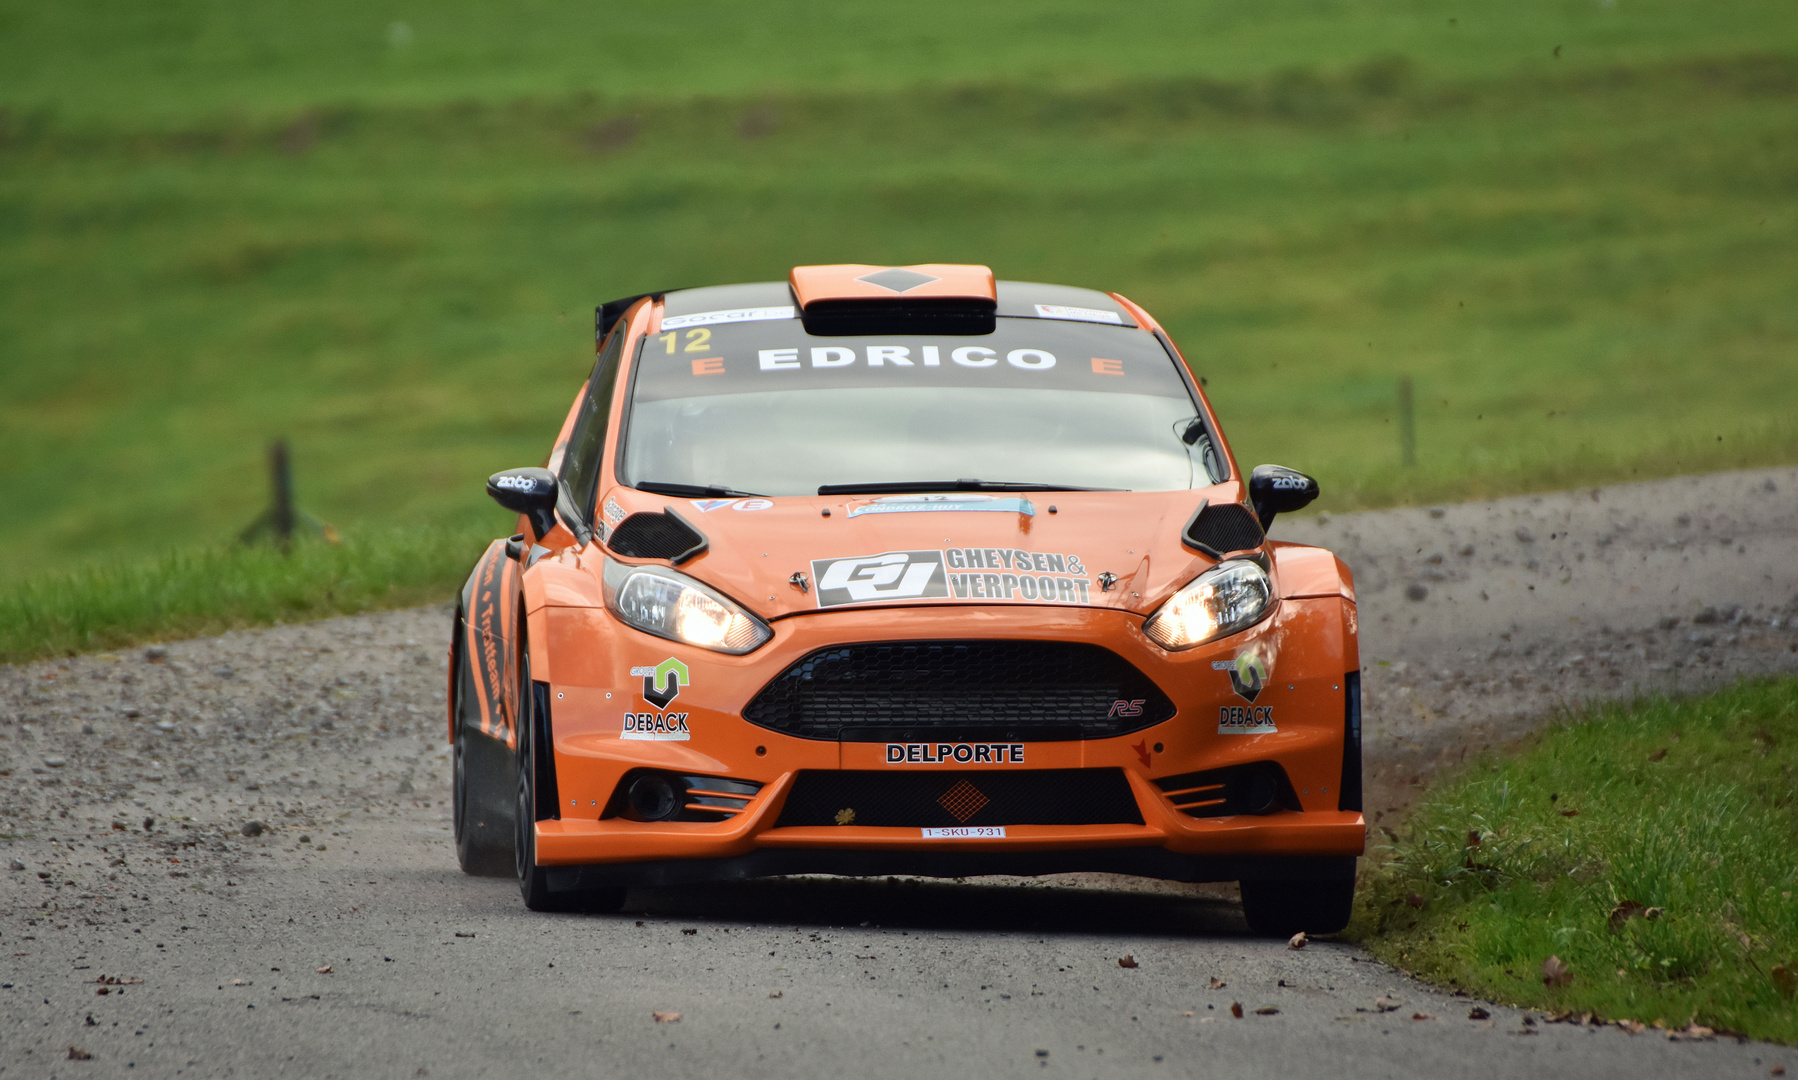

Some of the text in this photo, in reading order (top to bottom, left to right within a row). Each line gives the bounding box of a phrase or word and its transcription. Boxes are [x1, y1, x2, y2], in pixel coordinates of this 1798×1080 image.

[659, 328, 711, 354] 12
[692, 346, 1125, 376] E EDRICO E
[949, 573, 1091, 604] VERPOORT
[623, 712, 690, 732] DEBACK
[1219, 706, 1275, 726] DEBACK
[886, 743, 1024, 764] DELPORTE
[926, 827, 1002, 837] 1-SKU-931
